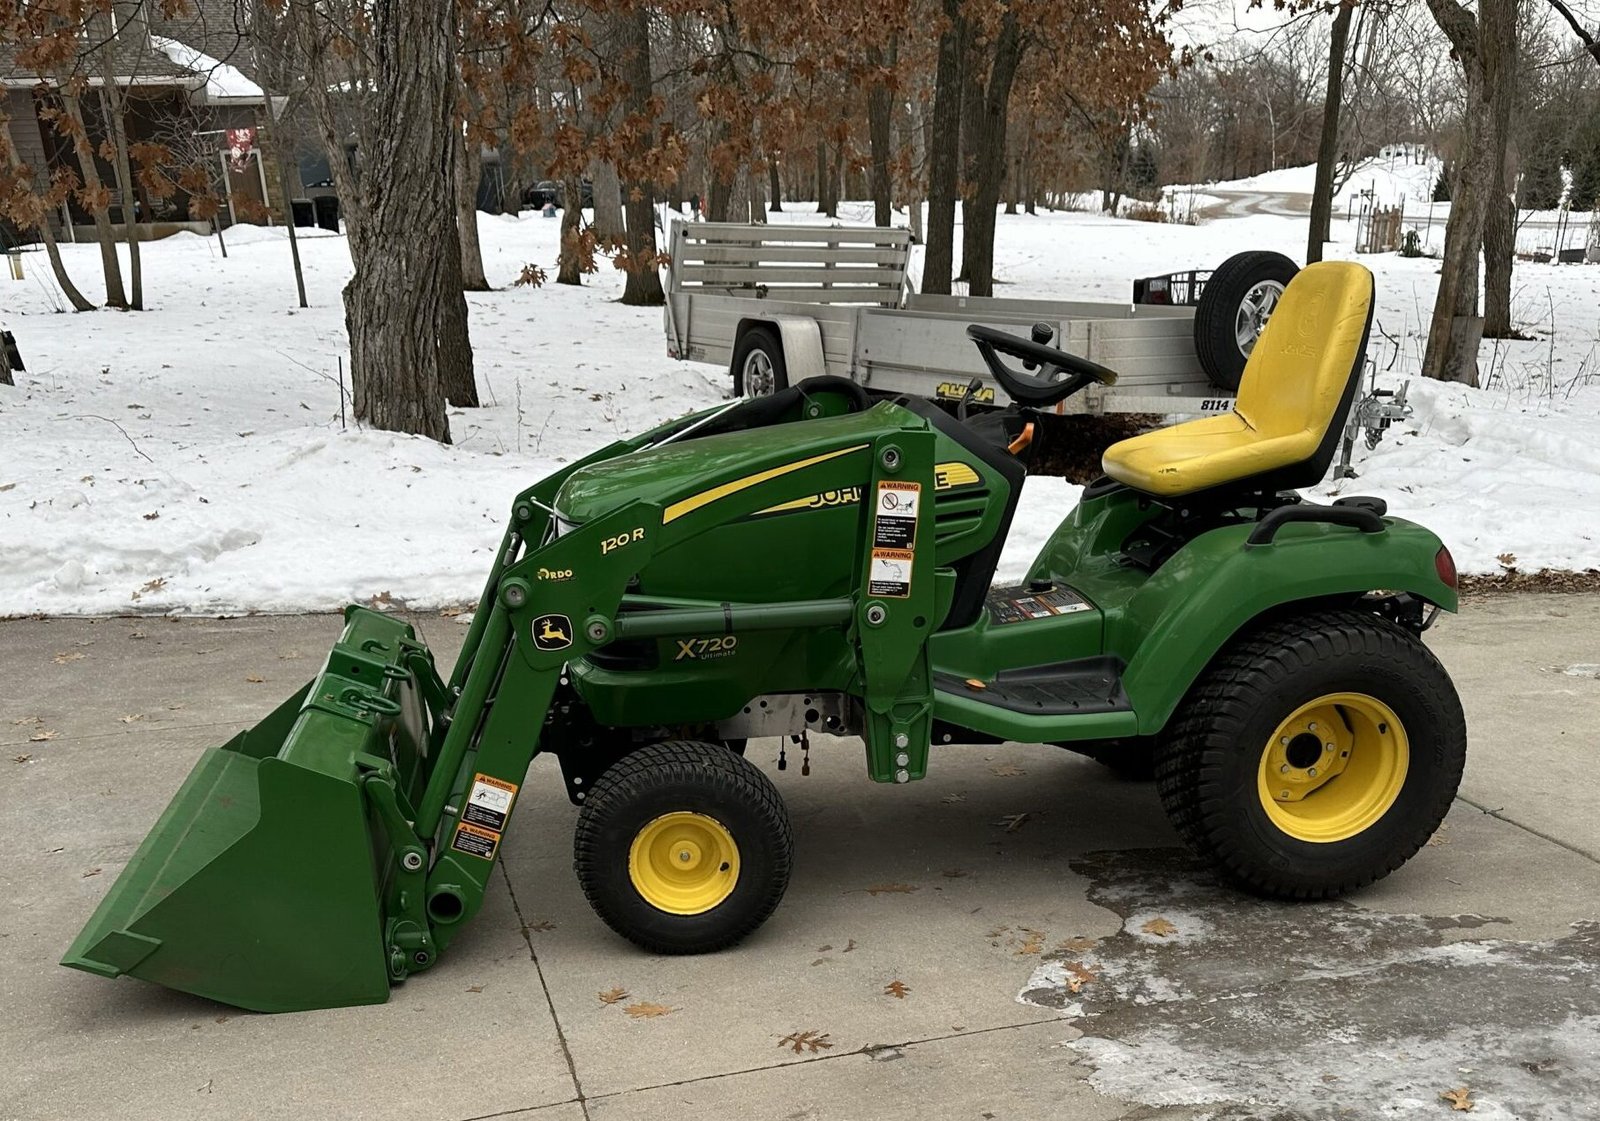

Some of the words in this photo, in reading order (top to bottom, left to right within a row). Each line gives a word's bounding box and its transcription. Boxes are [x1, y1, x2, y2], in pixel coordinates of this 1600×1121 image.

[1200, 400, 1230, 411] 8114
[886, 482, 919, 491] WARNING
[809, 486, 862, 507] JOH
[880, 551, 912, 559] WARNING
[675, 635, 737, 660] X720
[701, 650, 736, 660] Ultimate
[486, 777, 514, 791] WARNING
[469, 827, 496, 840] WARNING
